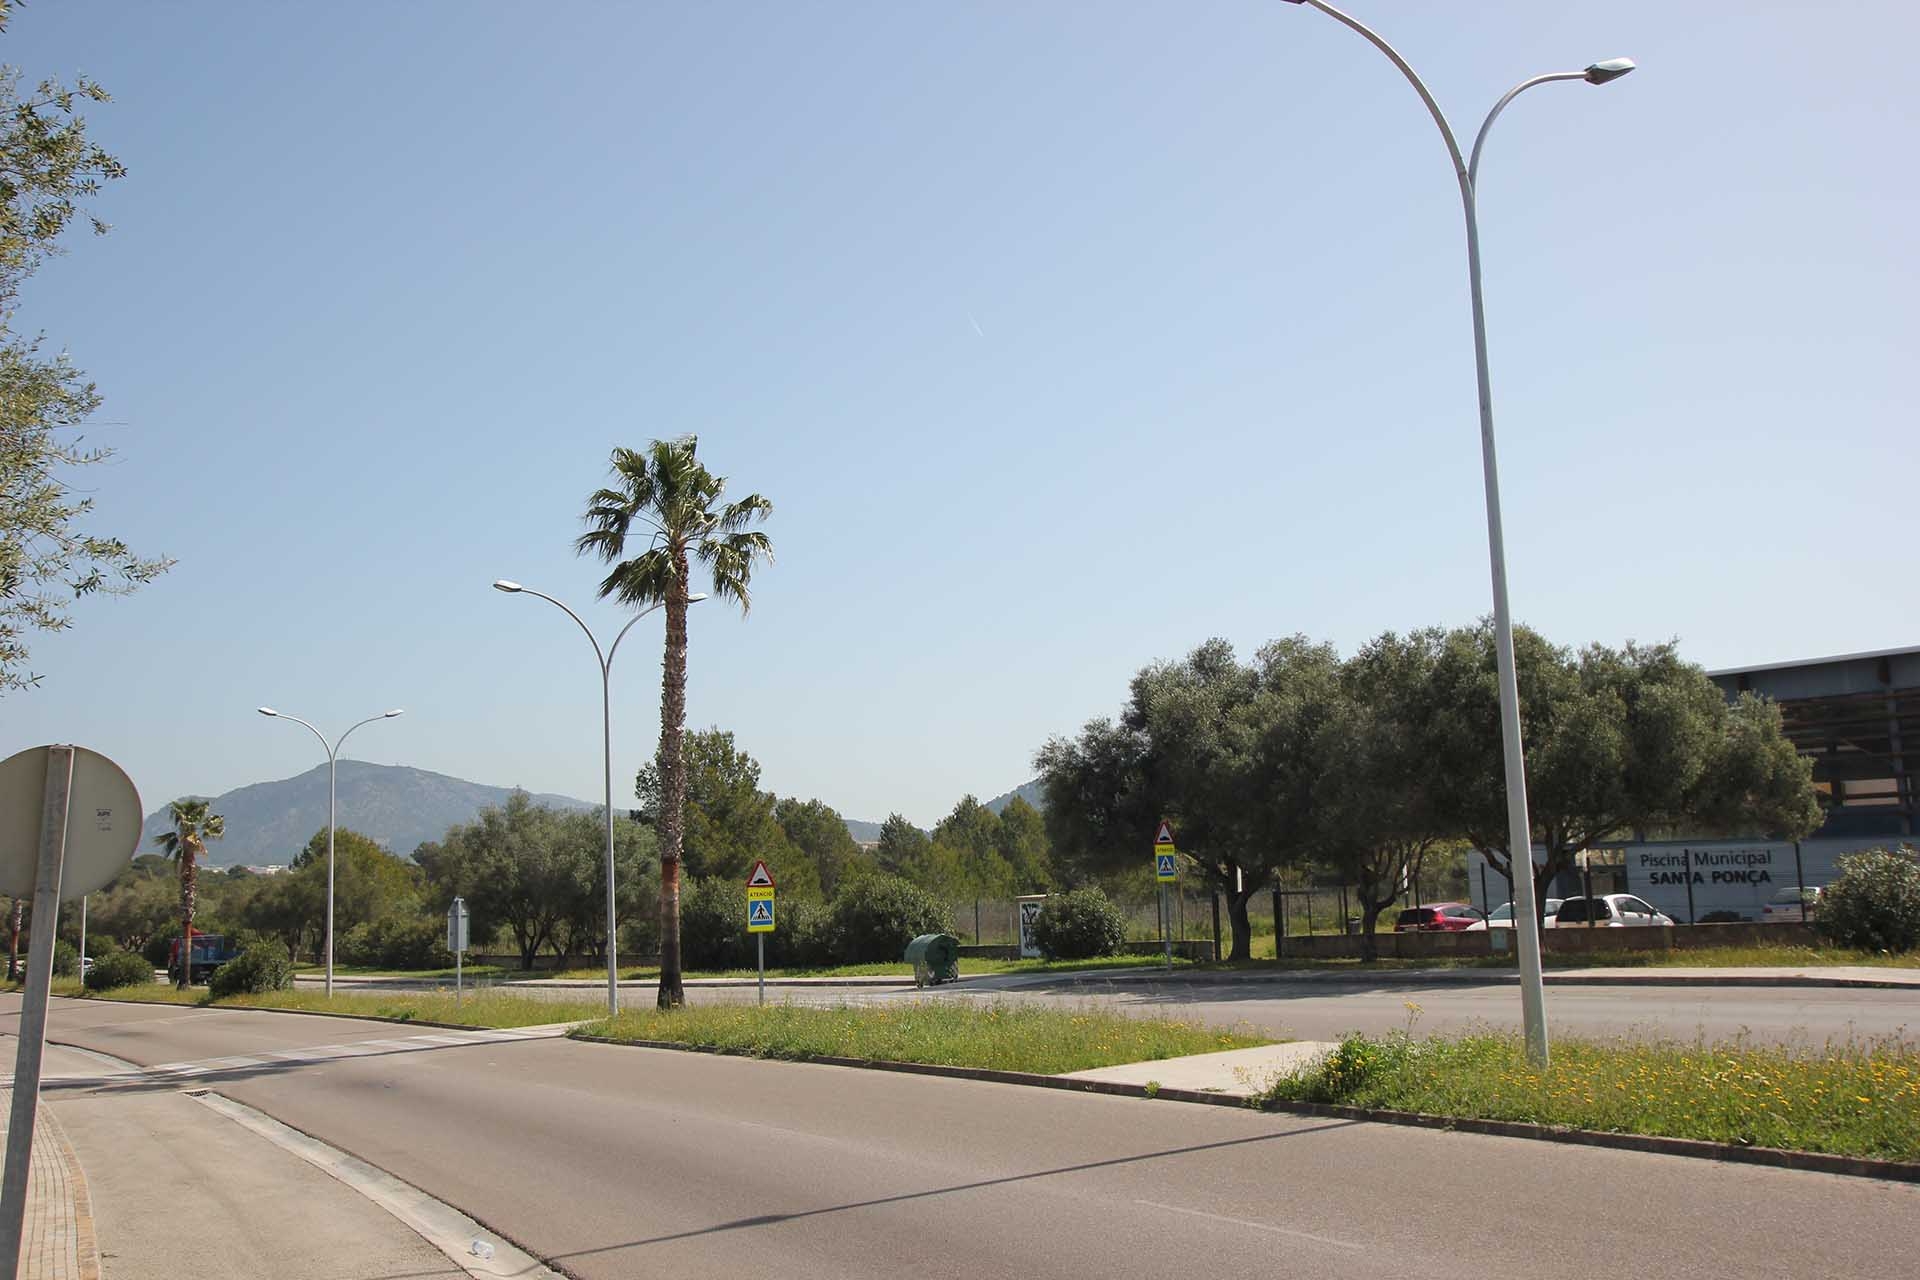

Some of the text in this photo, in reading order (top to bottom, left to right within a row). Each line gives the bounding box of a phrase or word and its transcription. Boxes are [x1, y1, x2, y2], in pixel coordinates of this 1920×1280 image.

[1640, 849, 1771, 867] Piscina Municipal
[1649, 870, 1771, 887] SANTA PONÇA
